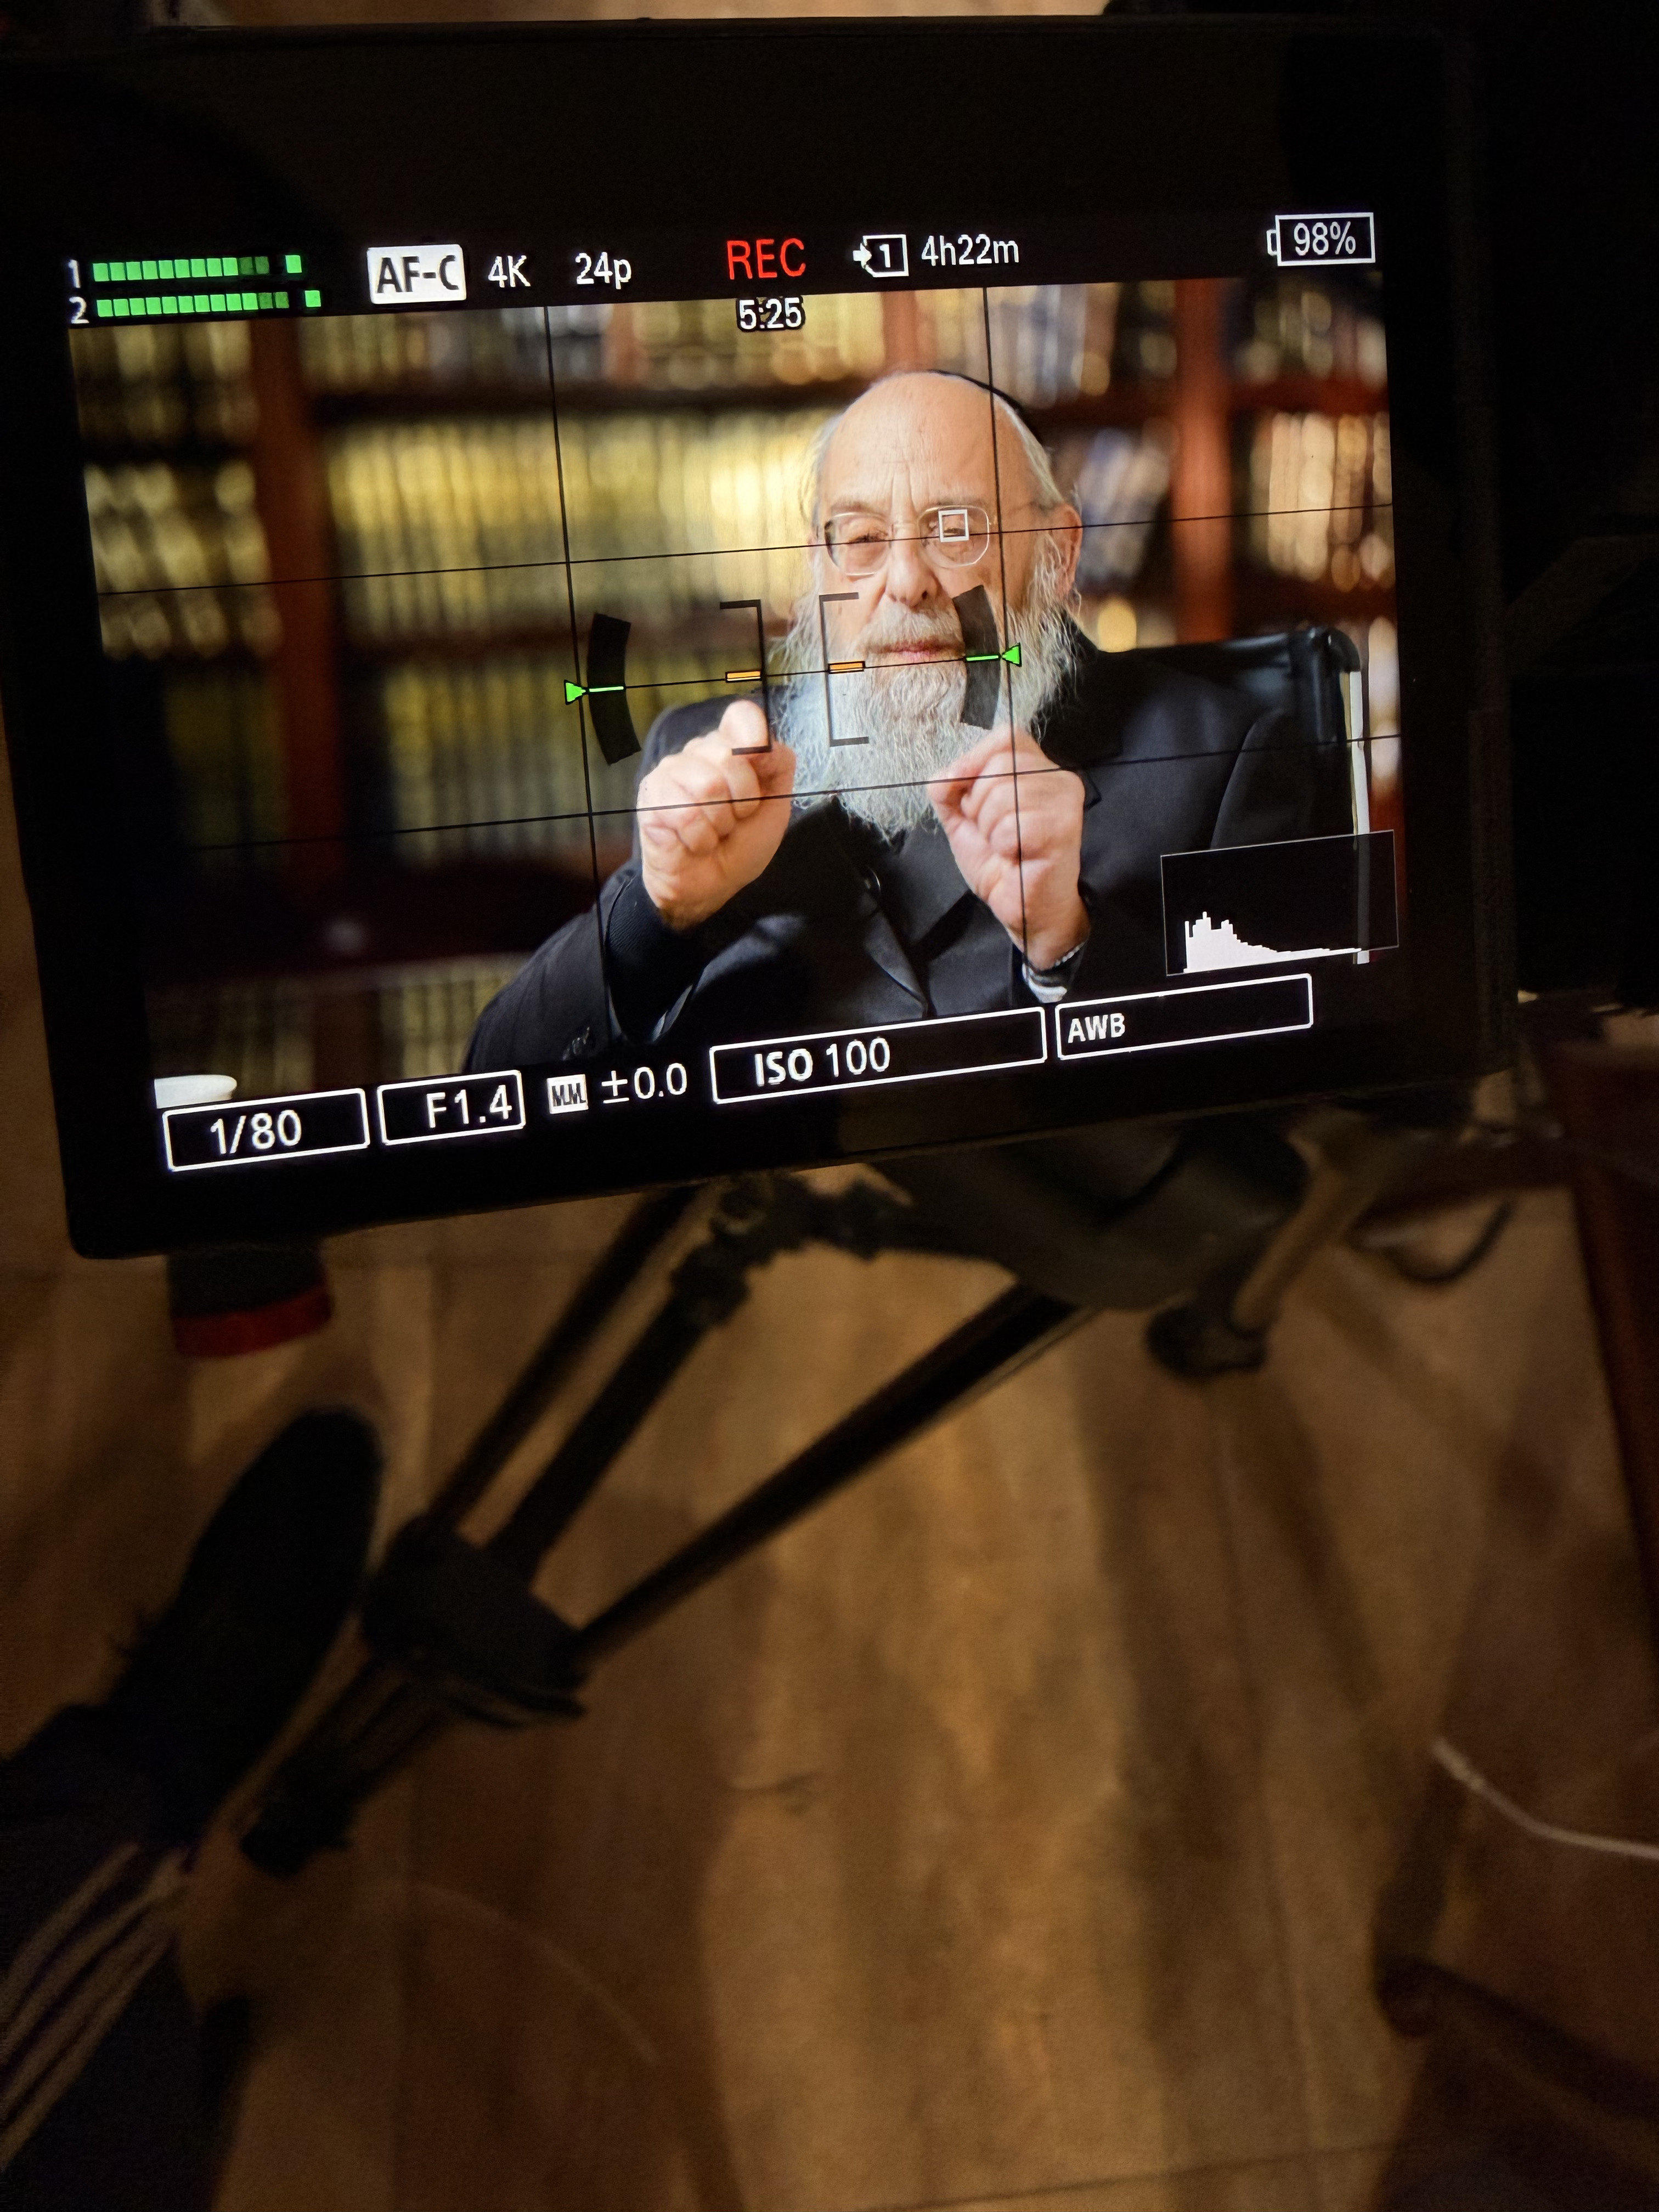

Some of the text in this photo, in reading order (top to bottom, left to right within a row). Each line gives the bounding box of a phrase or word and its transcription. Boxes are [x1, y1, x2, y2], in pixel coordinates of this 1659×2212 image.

[879, 244, 891, 268] 1
[921, 233, 1019, 267] 4h22m
[1293, 221, 1357, 257] 98%
[67, 259, 81, 289] 1
[376, 255, 458, 294] AF-C
[488, 255, 531, 288] 4K
[575, 251, 632, 290] 24p
[727, 238, 806, 280] REC
[69, 296, 89, 325] 2
[737, 296, 804, 330] 5:25
[1067, 1013, 1127, 1045] AWB
[754, 1036, 891, 1088] ISO 100
[601, 1062, 687, 1104] ±0.0
[426, 1085, 512, 1130] F1.4
[210, 1109, 302, 1156] 1/80
